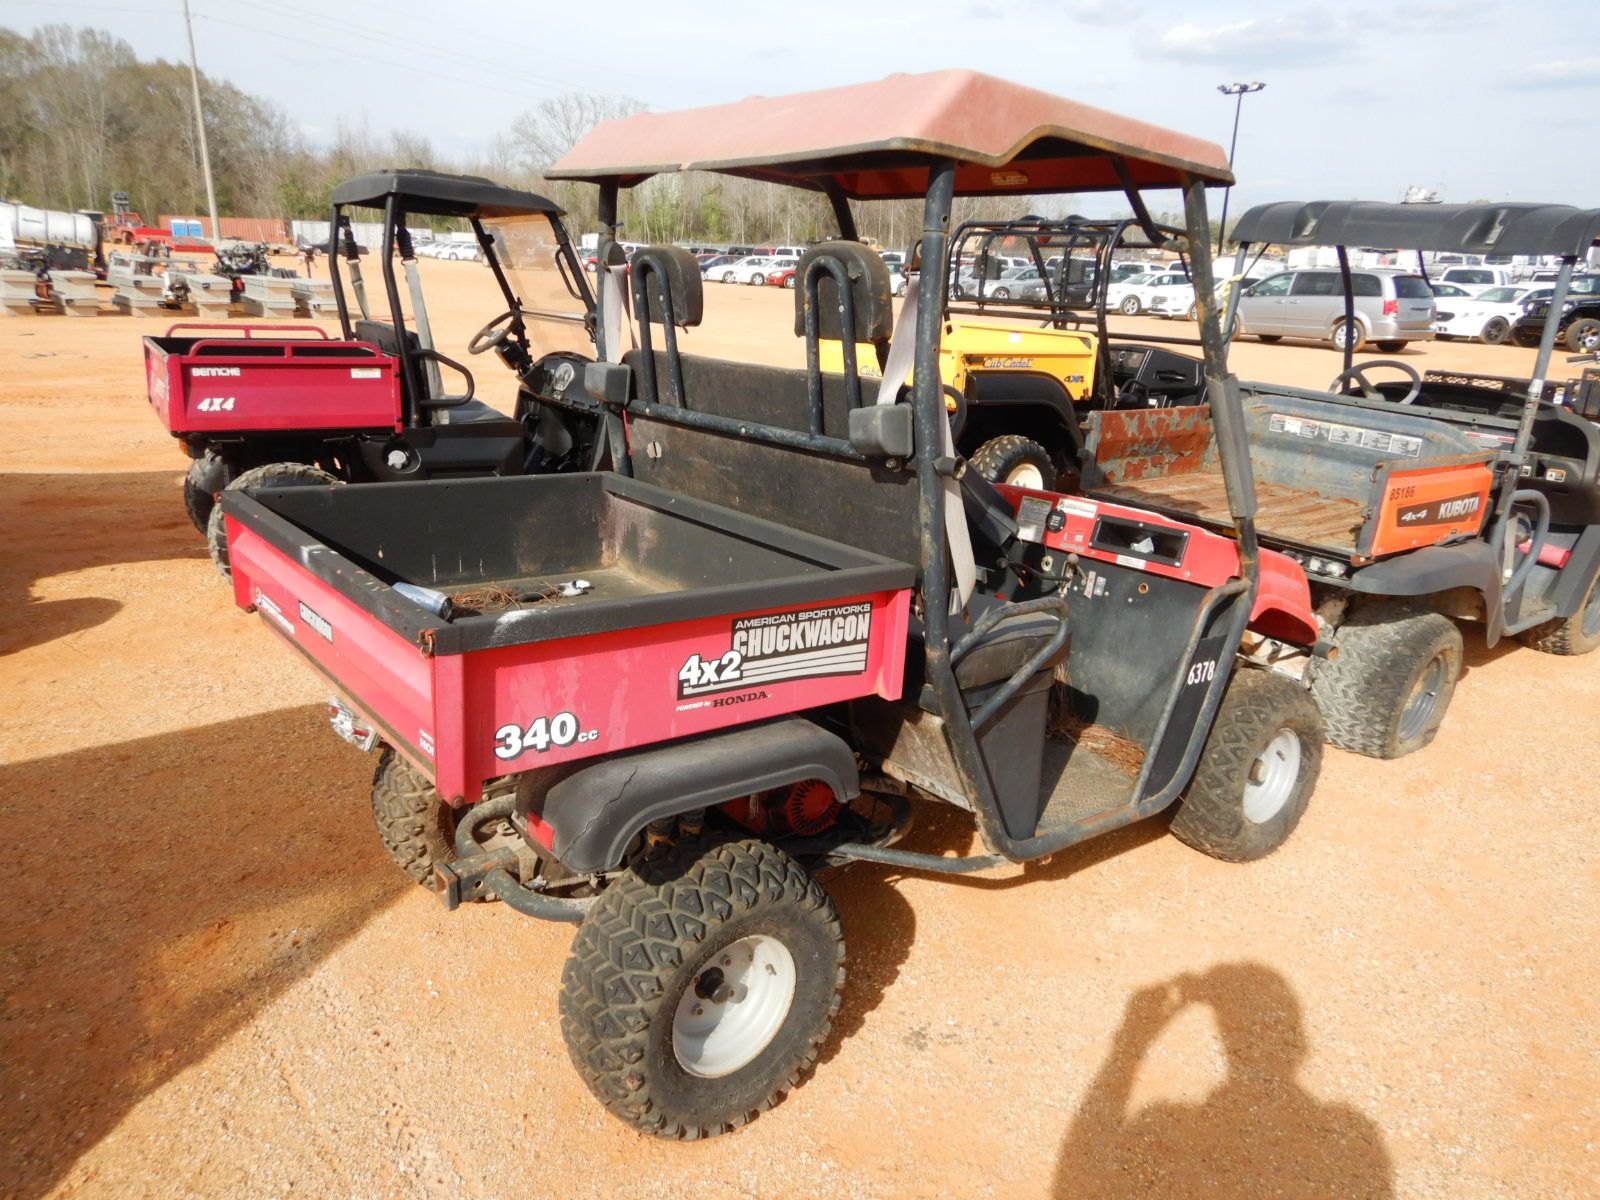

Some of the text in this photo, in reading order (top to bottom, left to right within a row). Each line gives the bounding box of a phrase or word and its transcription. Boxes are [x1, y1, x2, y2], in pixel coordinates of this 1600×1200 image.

[1437, 496, 1480, 520] KUBOTA
[735, 603, 872, 630] AMERICAN SPORTWORKS
[733, 612, 871, 658] CHUCKWAGON
[678, 649, 743, 688] 4x2
[1187, 660, 1216, 685] 6378
[712, 690, 769, 708] HONDA
